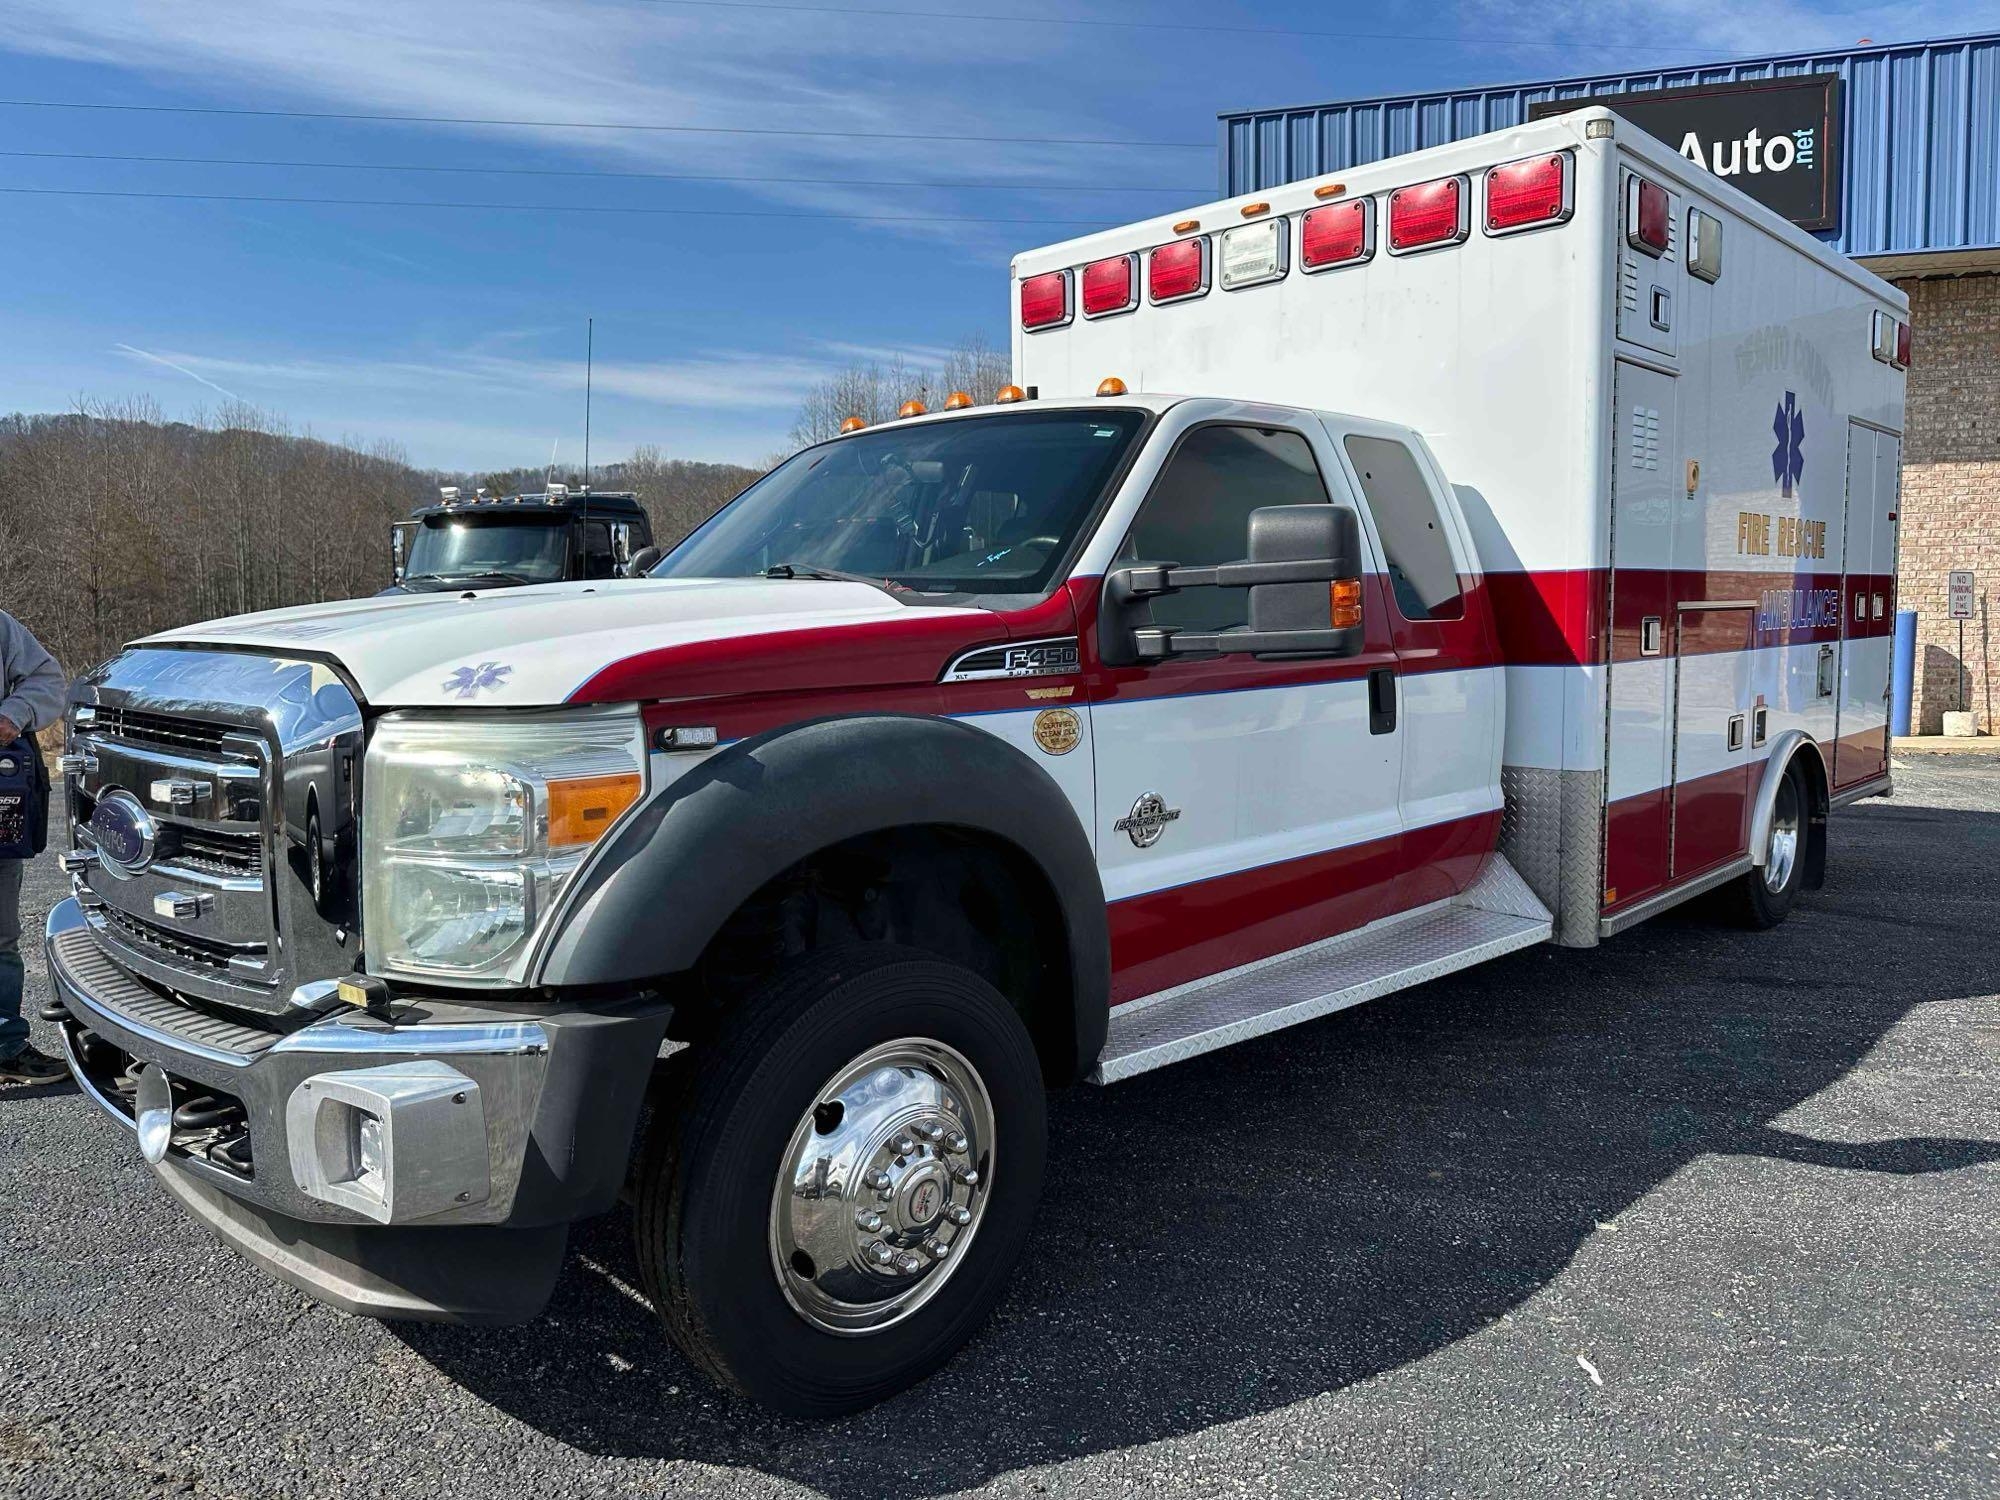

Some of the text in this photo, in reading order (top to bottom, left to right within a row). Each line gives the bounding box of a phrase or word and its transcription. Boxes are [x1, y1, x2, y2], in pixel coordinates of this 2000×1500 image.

[1679, 128, 1795, 177] Auto
[1792, 128, 1814, 170] .net
[1738, 512, 1826, 559] FIRE RESCUE
[1956, 575, 1967, 585] NO
[1951, 584, 1972, 594] PARKING
[1956, 594, 1967, 602] ANY
[1758, 589, 1839, 631] AMBULANCE
[1955, 601, 1968, 610] TIME
[1004, 647, 1079, 671] F-450
[954, 673, 969, 681] XLT
[1040, 729, 1062, 738] CLEAN
